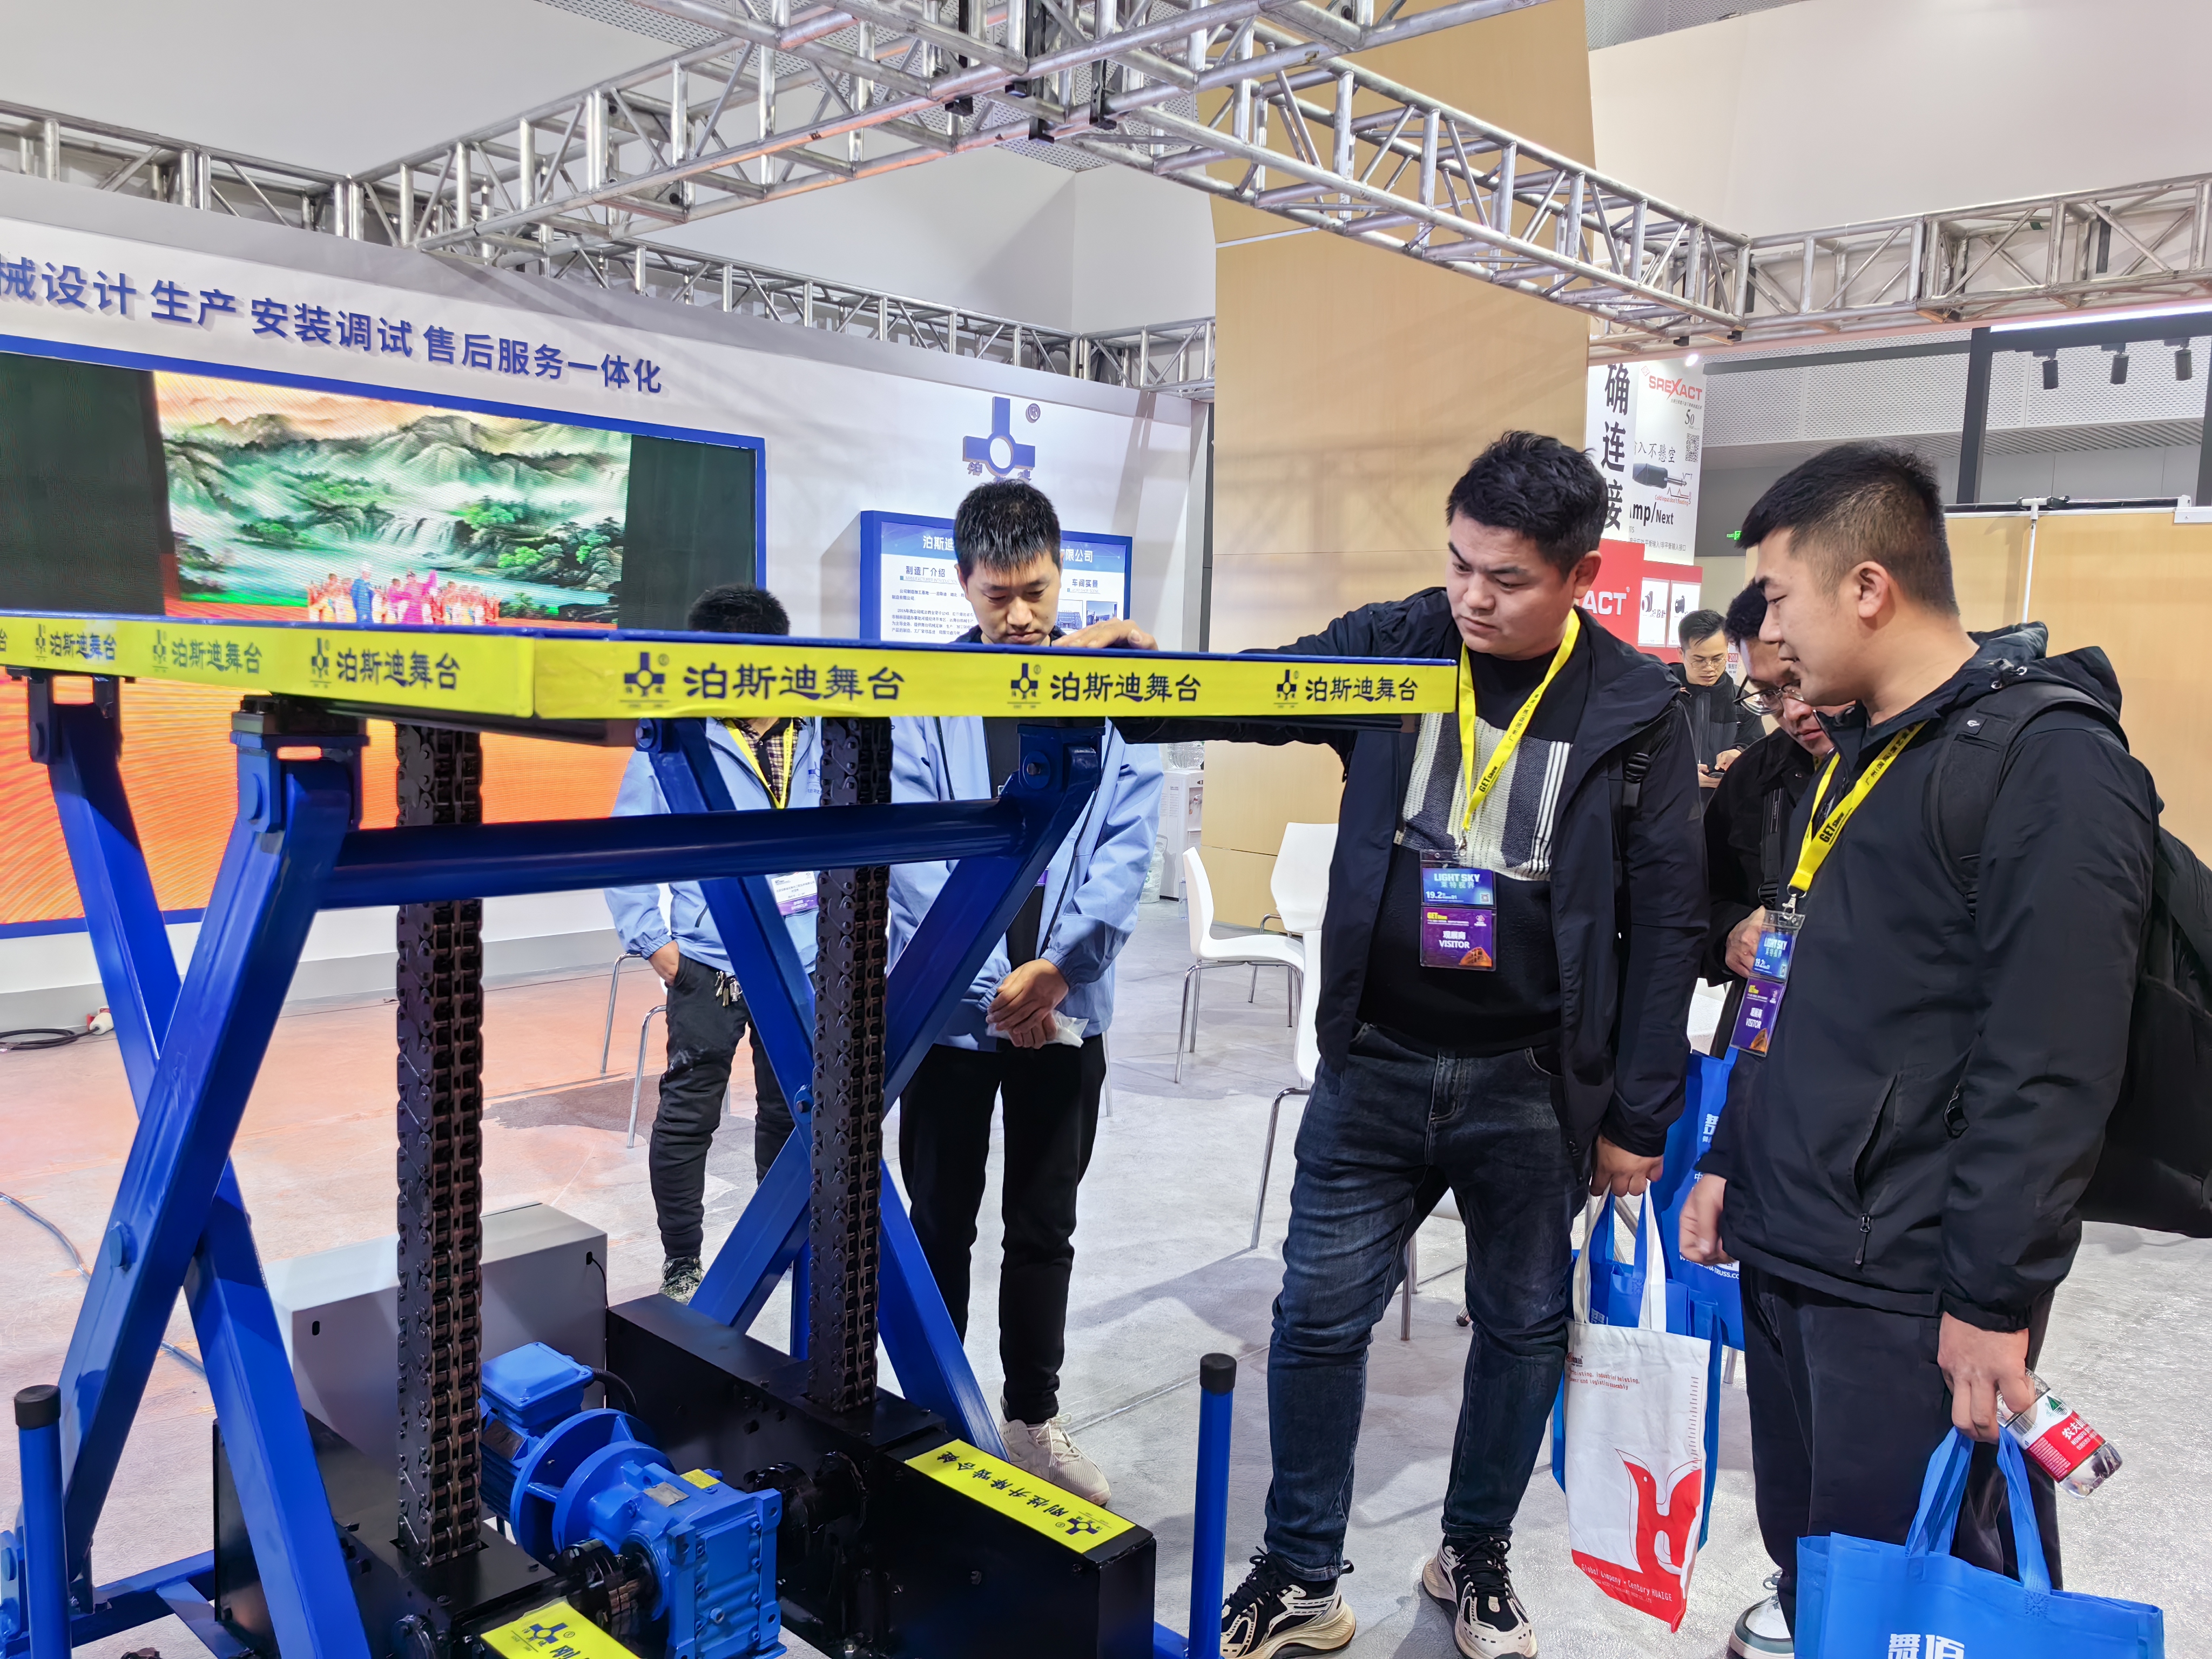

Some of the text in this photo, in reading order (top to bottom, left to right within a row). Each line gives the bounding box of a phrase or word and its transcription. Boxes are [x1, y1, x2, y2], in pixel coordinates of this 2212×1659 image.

[151, 279, 237, 326] 生产
[252, 298, 413, 358] 安装调试
[423, 325, 662, 394] 售后服务一体化
[1649, 375, 1702, 401] SREXACT
[906, 565, 945, 577] 制造厂介绍
[50, 631, 117, 661] 泊斯迪舞台
[172, 637, 262, 675] 泊斯迪舞台
[336, 648, 460, 690] 泊斯迪舞台
[683, 663, 905, 700] 泊斯迪舞台
[1050, 671, 1201, 703] 泊斯迪舞台
[1305, 676, 1418, 702] 泊斯迪舞台
[1434, 873, 1480, 882] LIGHT SKY
[1439, 940, 1470, 948] VISITOR
[1581, 1563, 1599, 1576] Global
[1627, 1580, 1650, 1596] Century
